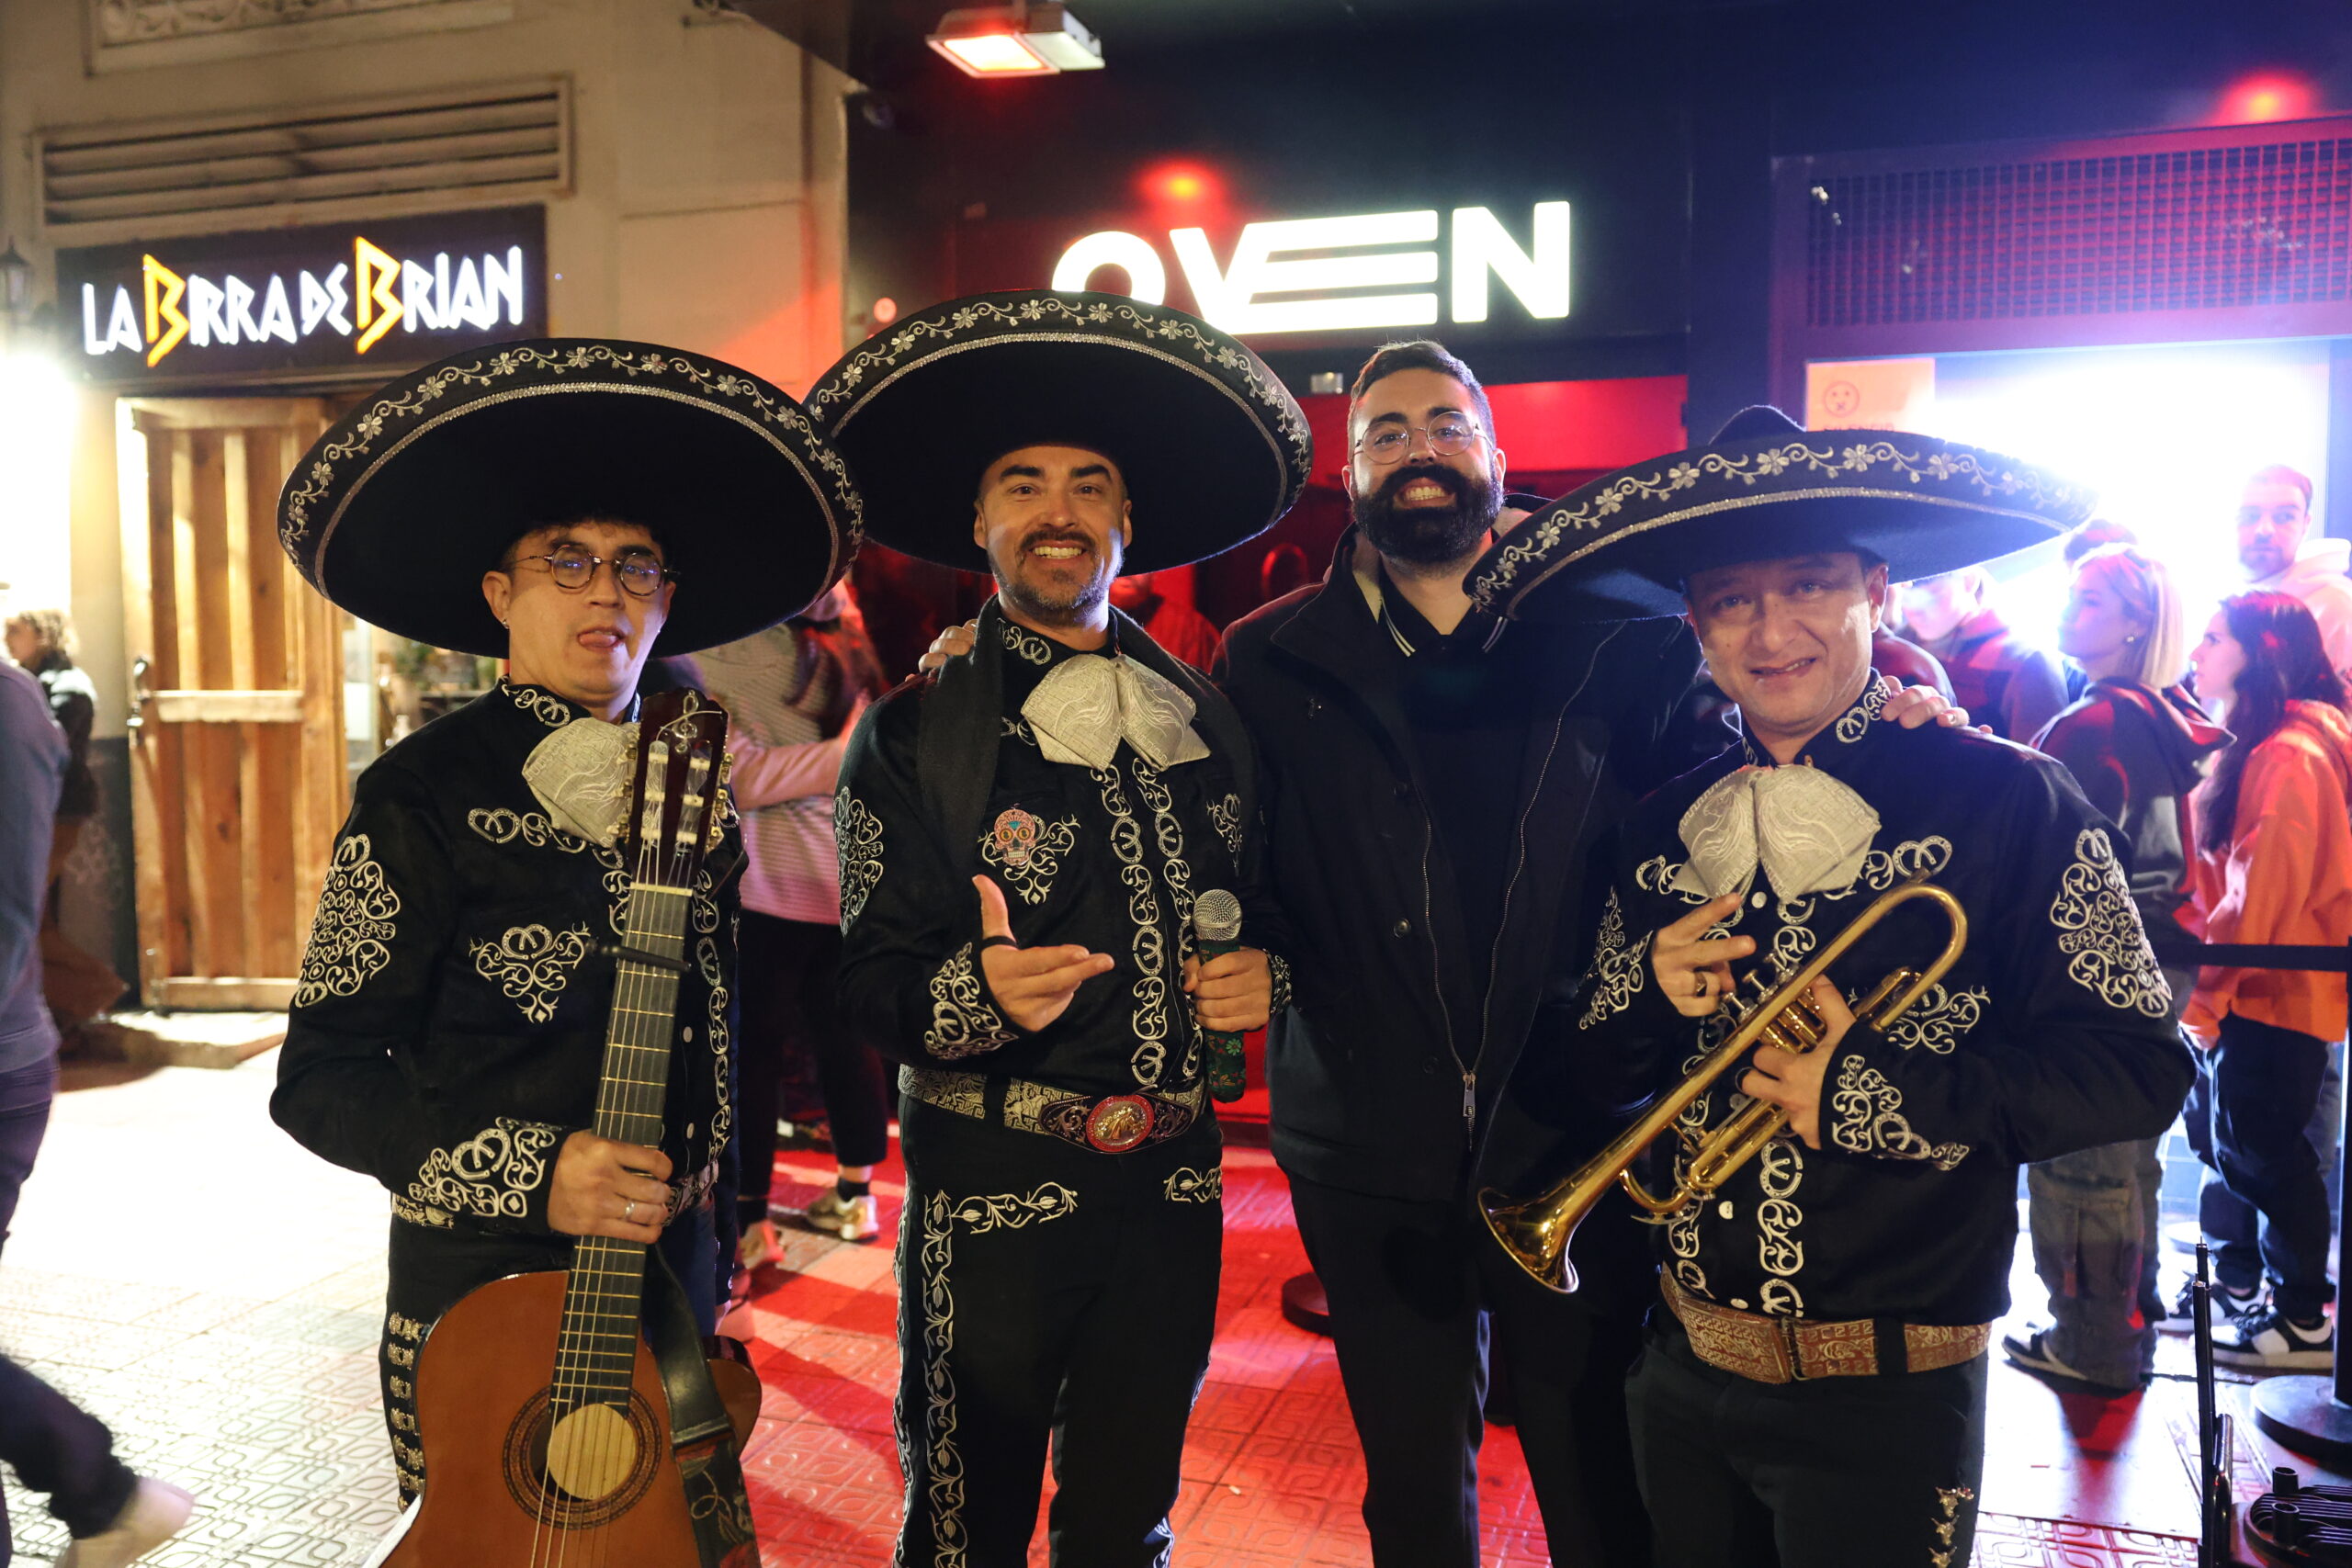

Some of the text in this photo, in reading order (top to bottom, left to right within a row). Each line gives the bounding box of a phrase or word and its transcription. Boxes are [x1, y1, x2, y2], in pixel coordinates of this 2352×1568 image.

[82, 283, 142, 355] LA
[300, 261, 353, 337] DE
[355, 236, 523, 355] BRIAN
[1052, 200, 1570, 334] OVEN
